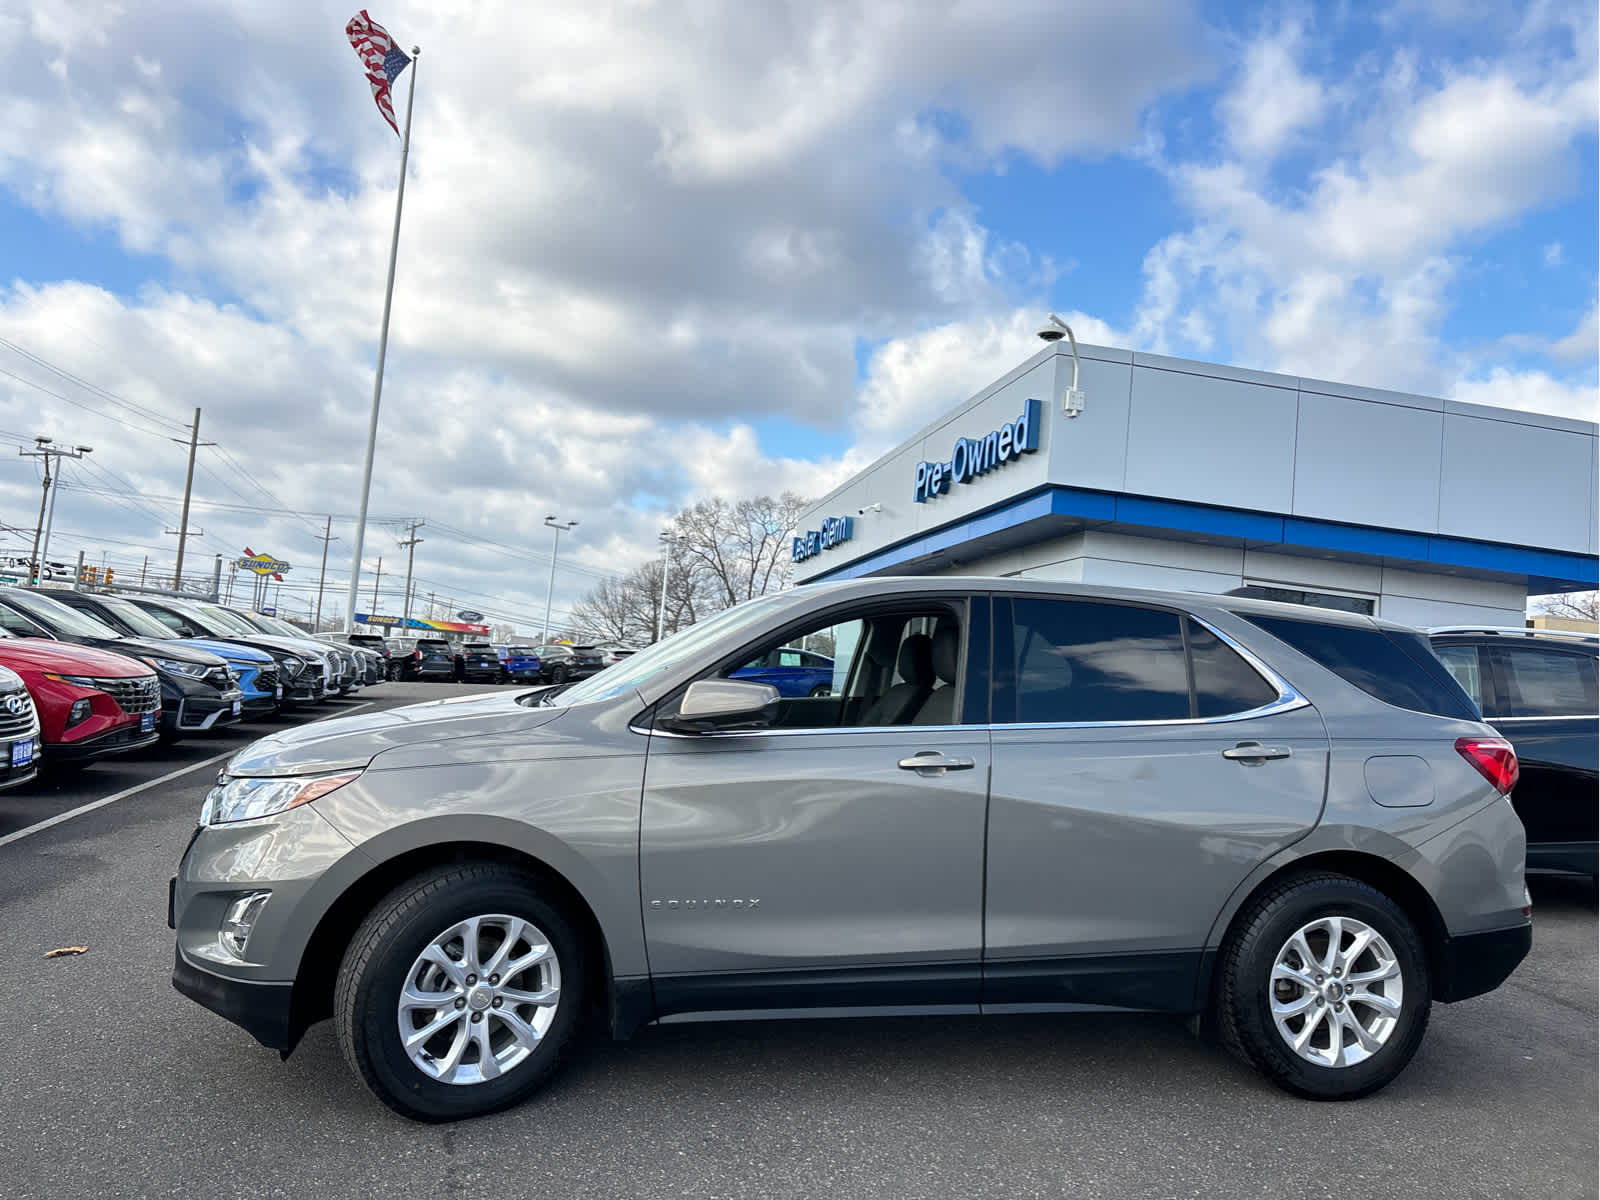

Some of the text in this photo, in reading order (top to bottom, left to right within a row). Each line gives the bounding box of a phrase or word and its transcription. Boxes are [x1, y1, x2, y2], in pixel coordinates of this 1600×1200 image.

[913, 398, 1041, 502] Pre-Owned
[820, 516, 853, 549] Glenn
[240, 559, 287, 572] SUNOCO
[367, 615, 399, 624] SUNOCO
[650, 898, 760, 909] EQUINOX
